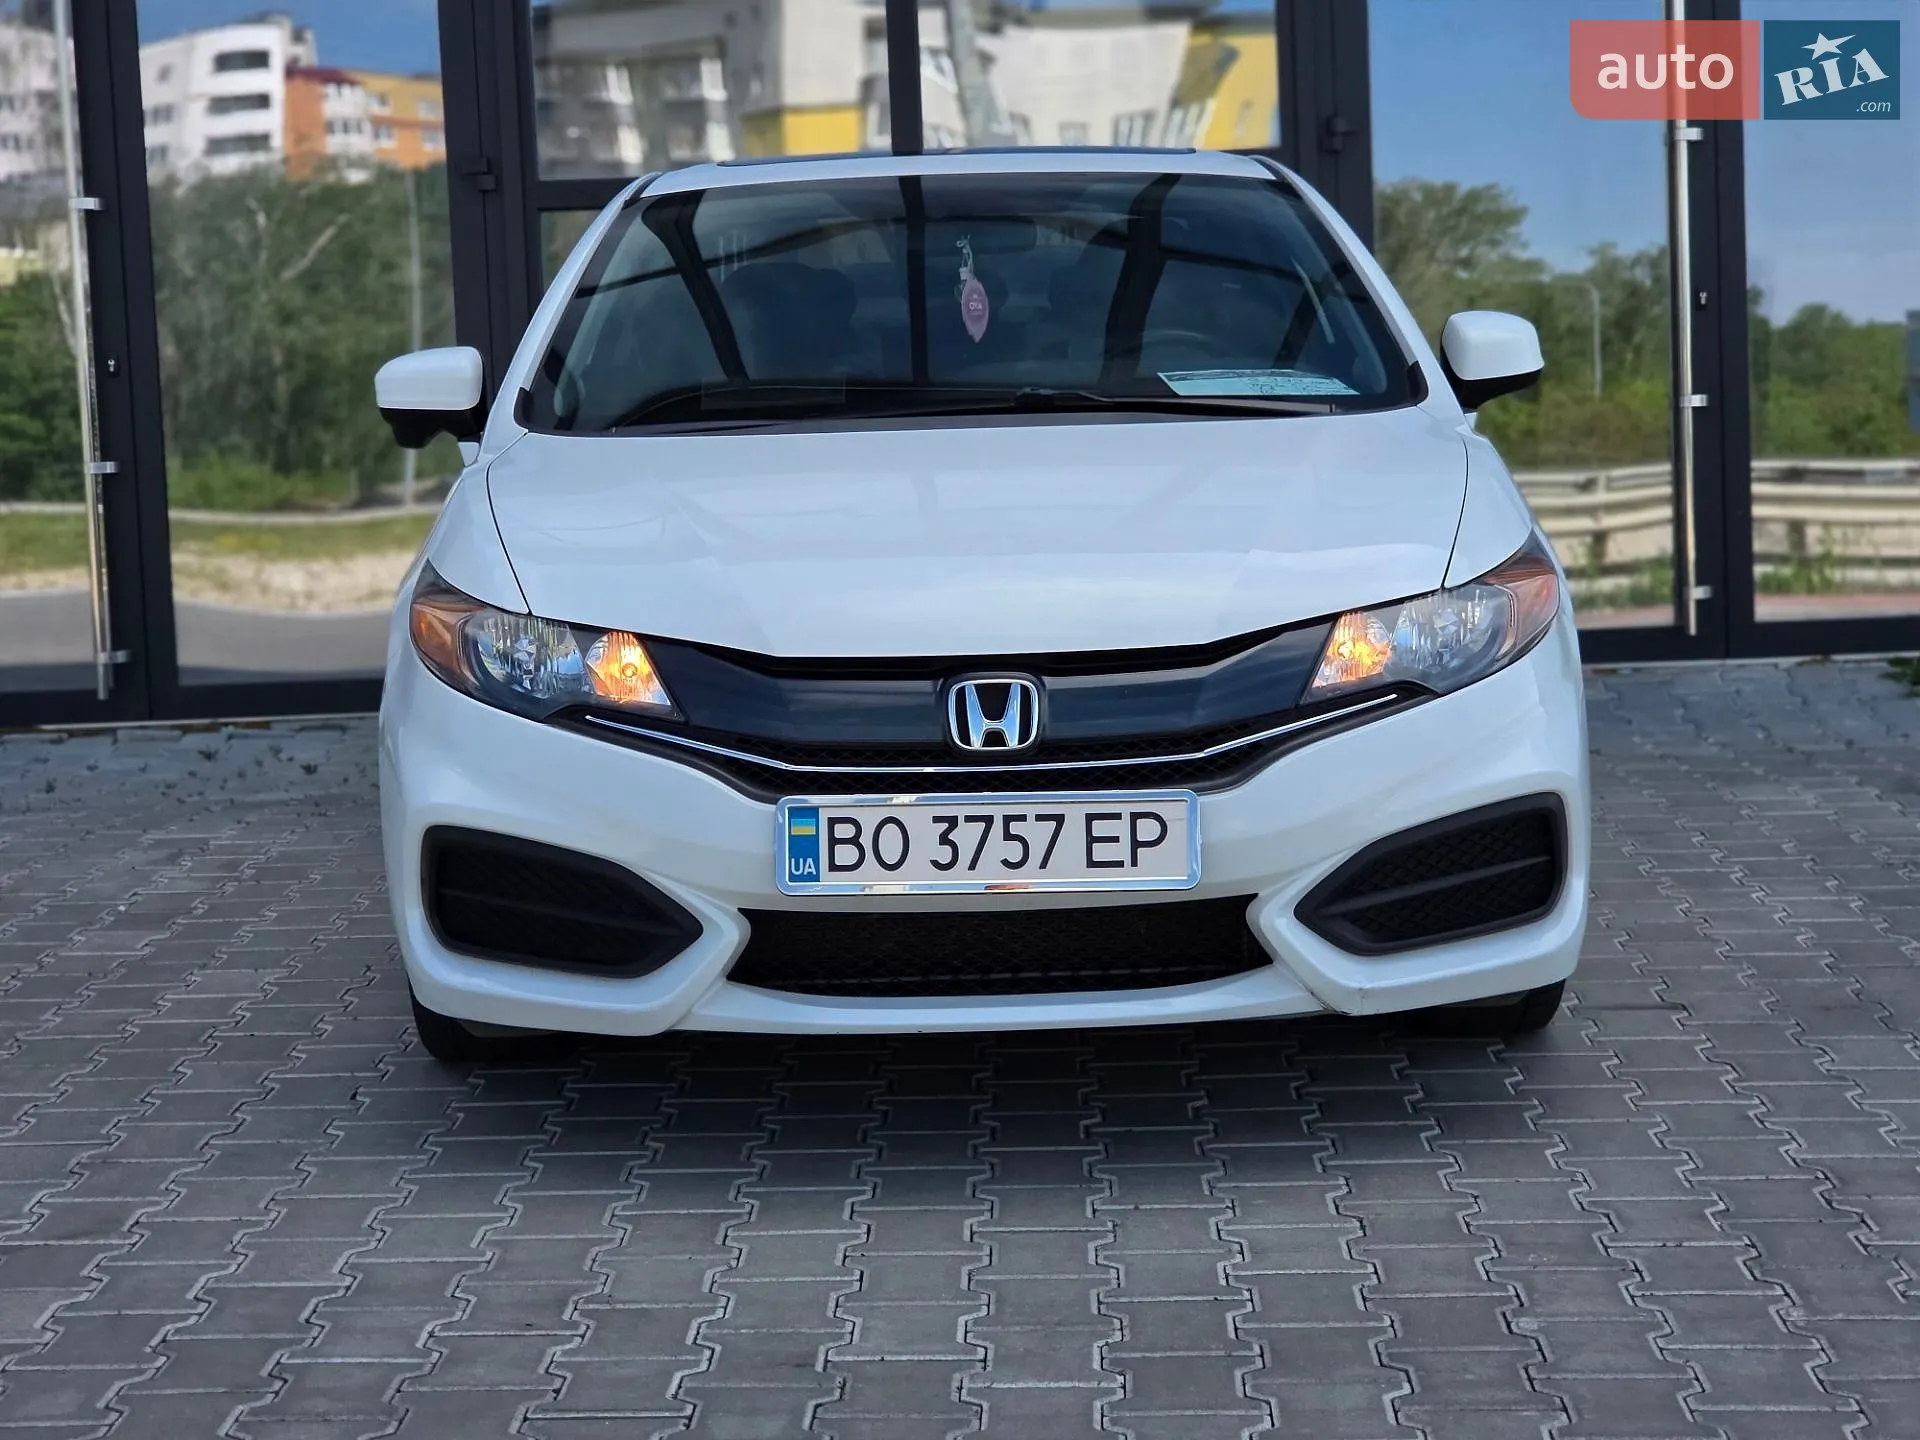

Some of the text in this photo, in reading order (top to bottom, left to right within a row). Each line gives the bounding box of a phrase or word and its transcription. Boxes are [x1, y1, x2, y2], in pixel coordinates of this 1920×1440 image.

[827, 811, 1169, 873] BO 3757 EP
[791, 857, 817, 876] UA
